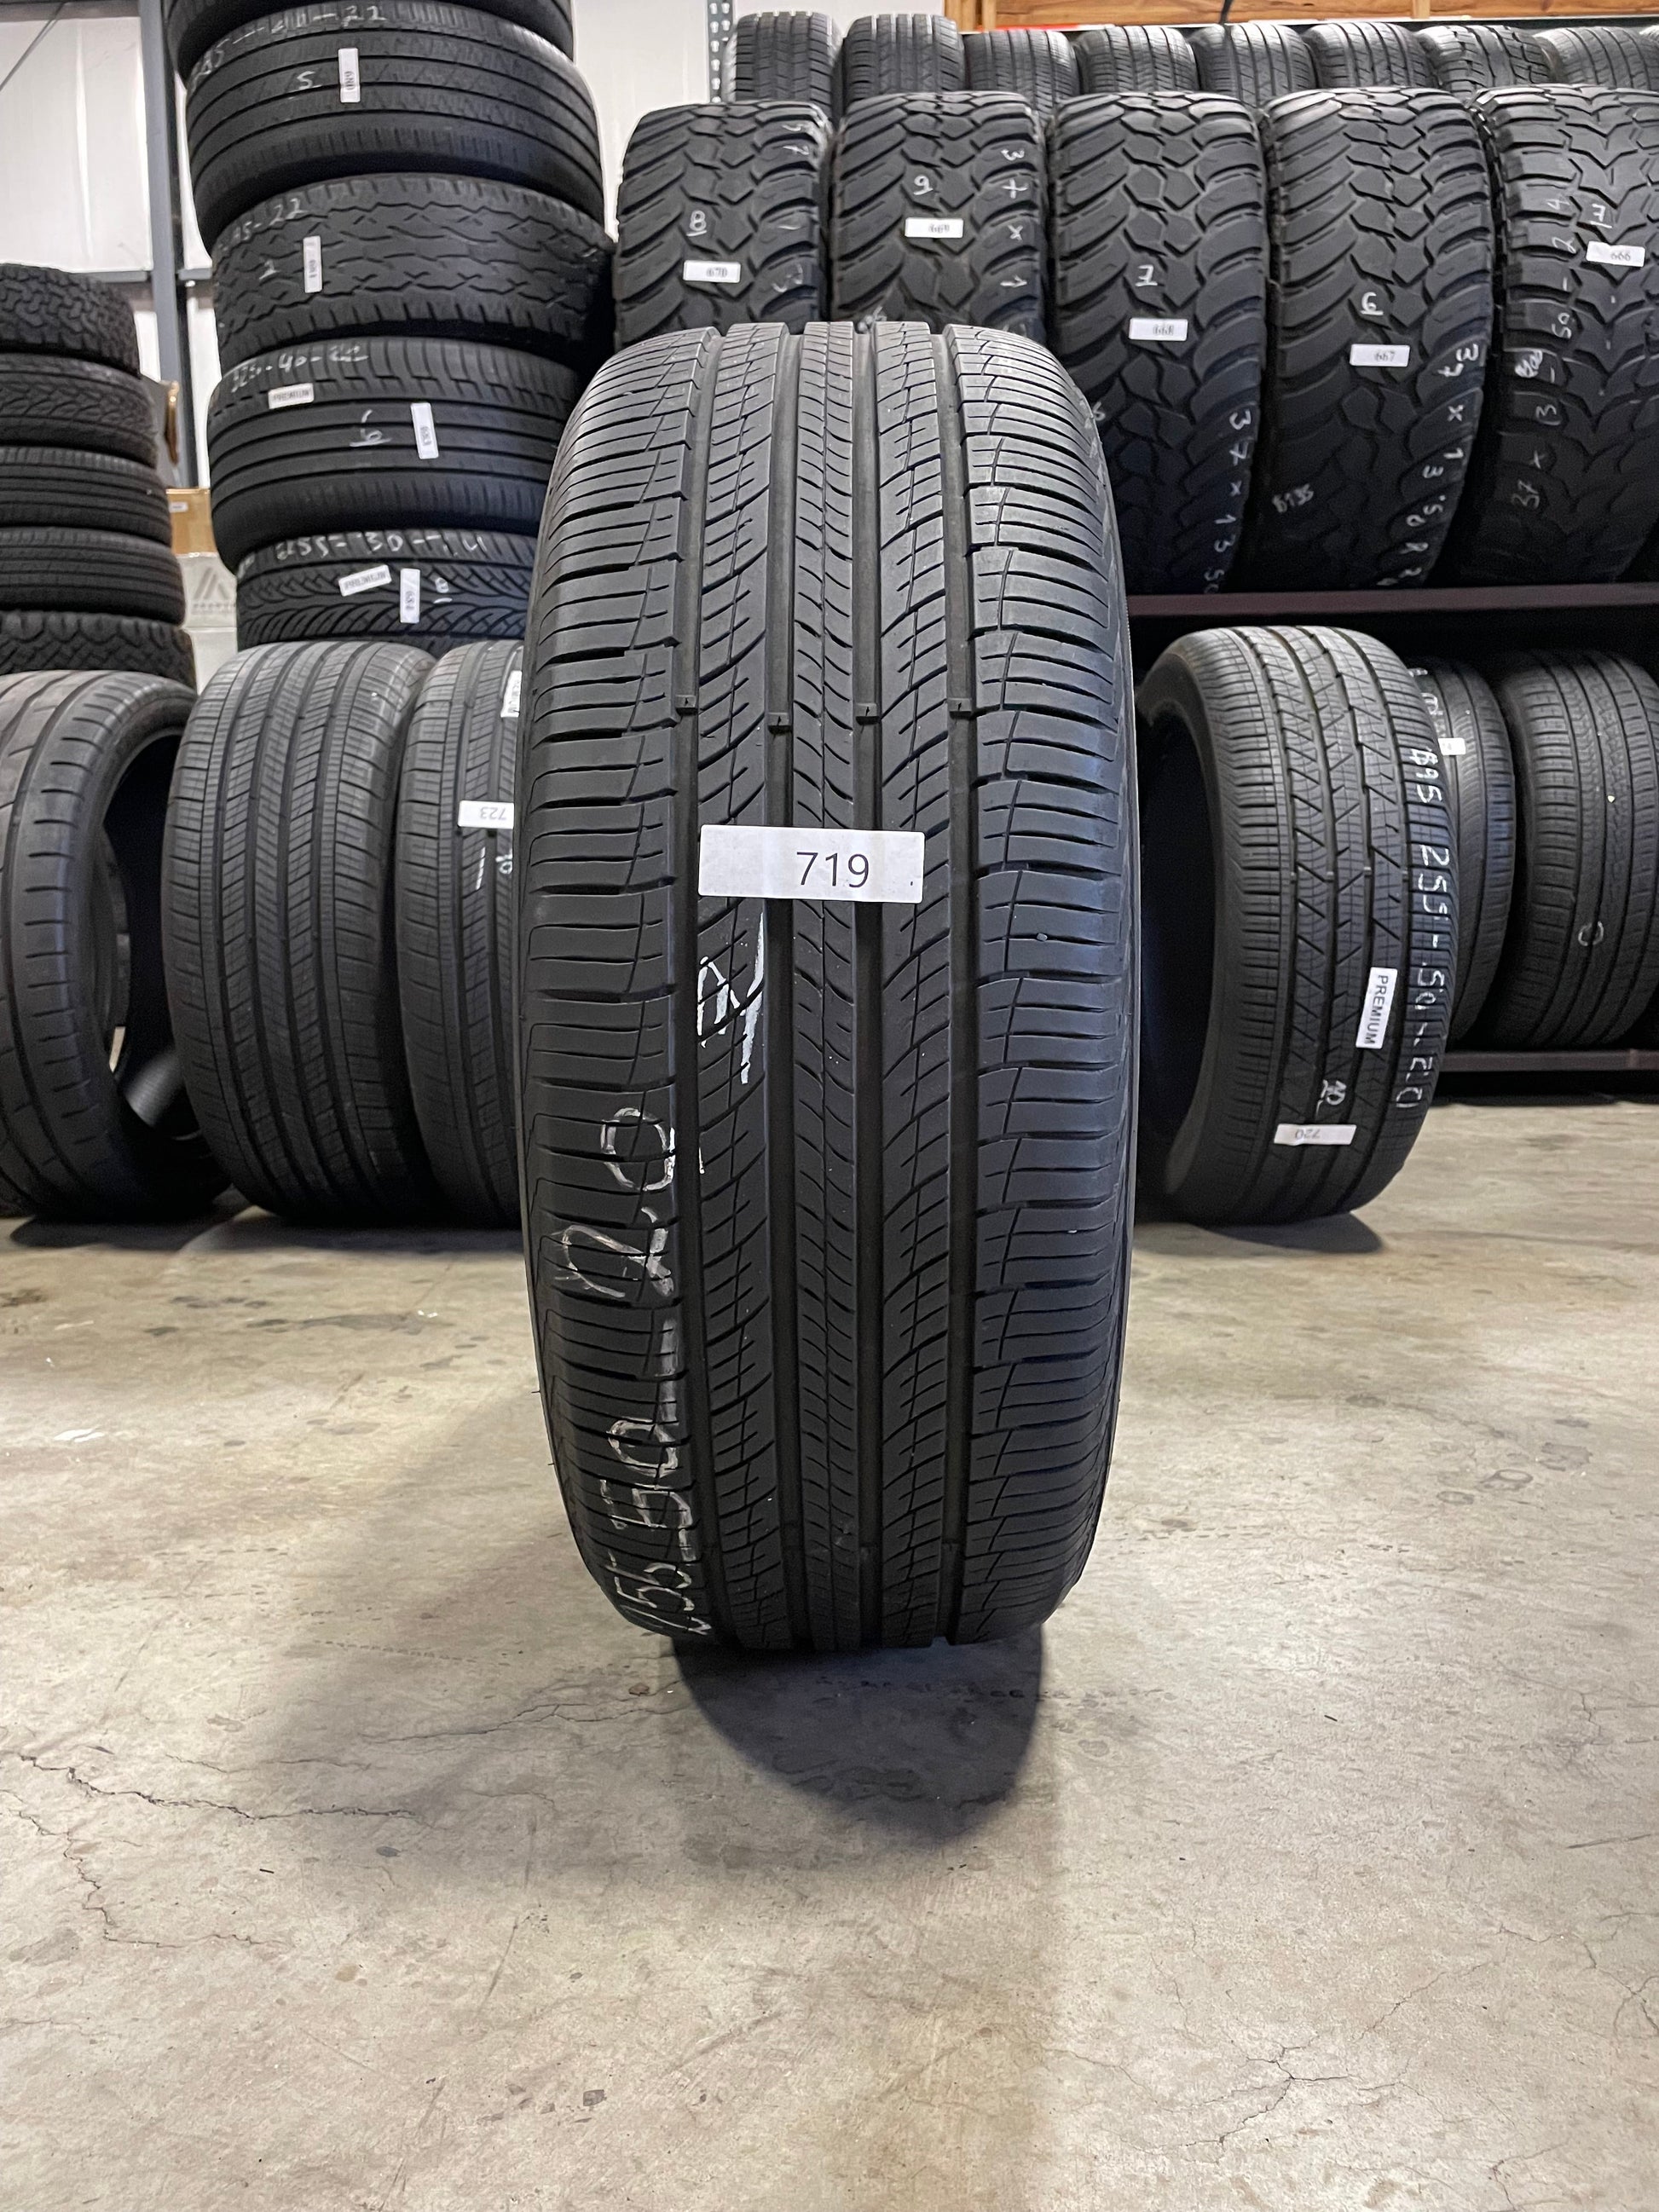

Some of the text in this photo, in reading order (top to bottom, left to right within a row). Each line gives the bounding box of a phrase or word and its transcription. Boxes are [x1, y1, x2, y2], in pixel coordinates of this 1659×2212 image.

[687, 211, 707, 236] 8
[1361, 292, 1384, 315] 6
[479, 806, 508, 820] 723
[796, 851, 870, 888] 719
[1364, 974, 1389, 1045] PREMIUM
[1295, 1128, 1321, 1140] 720
